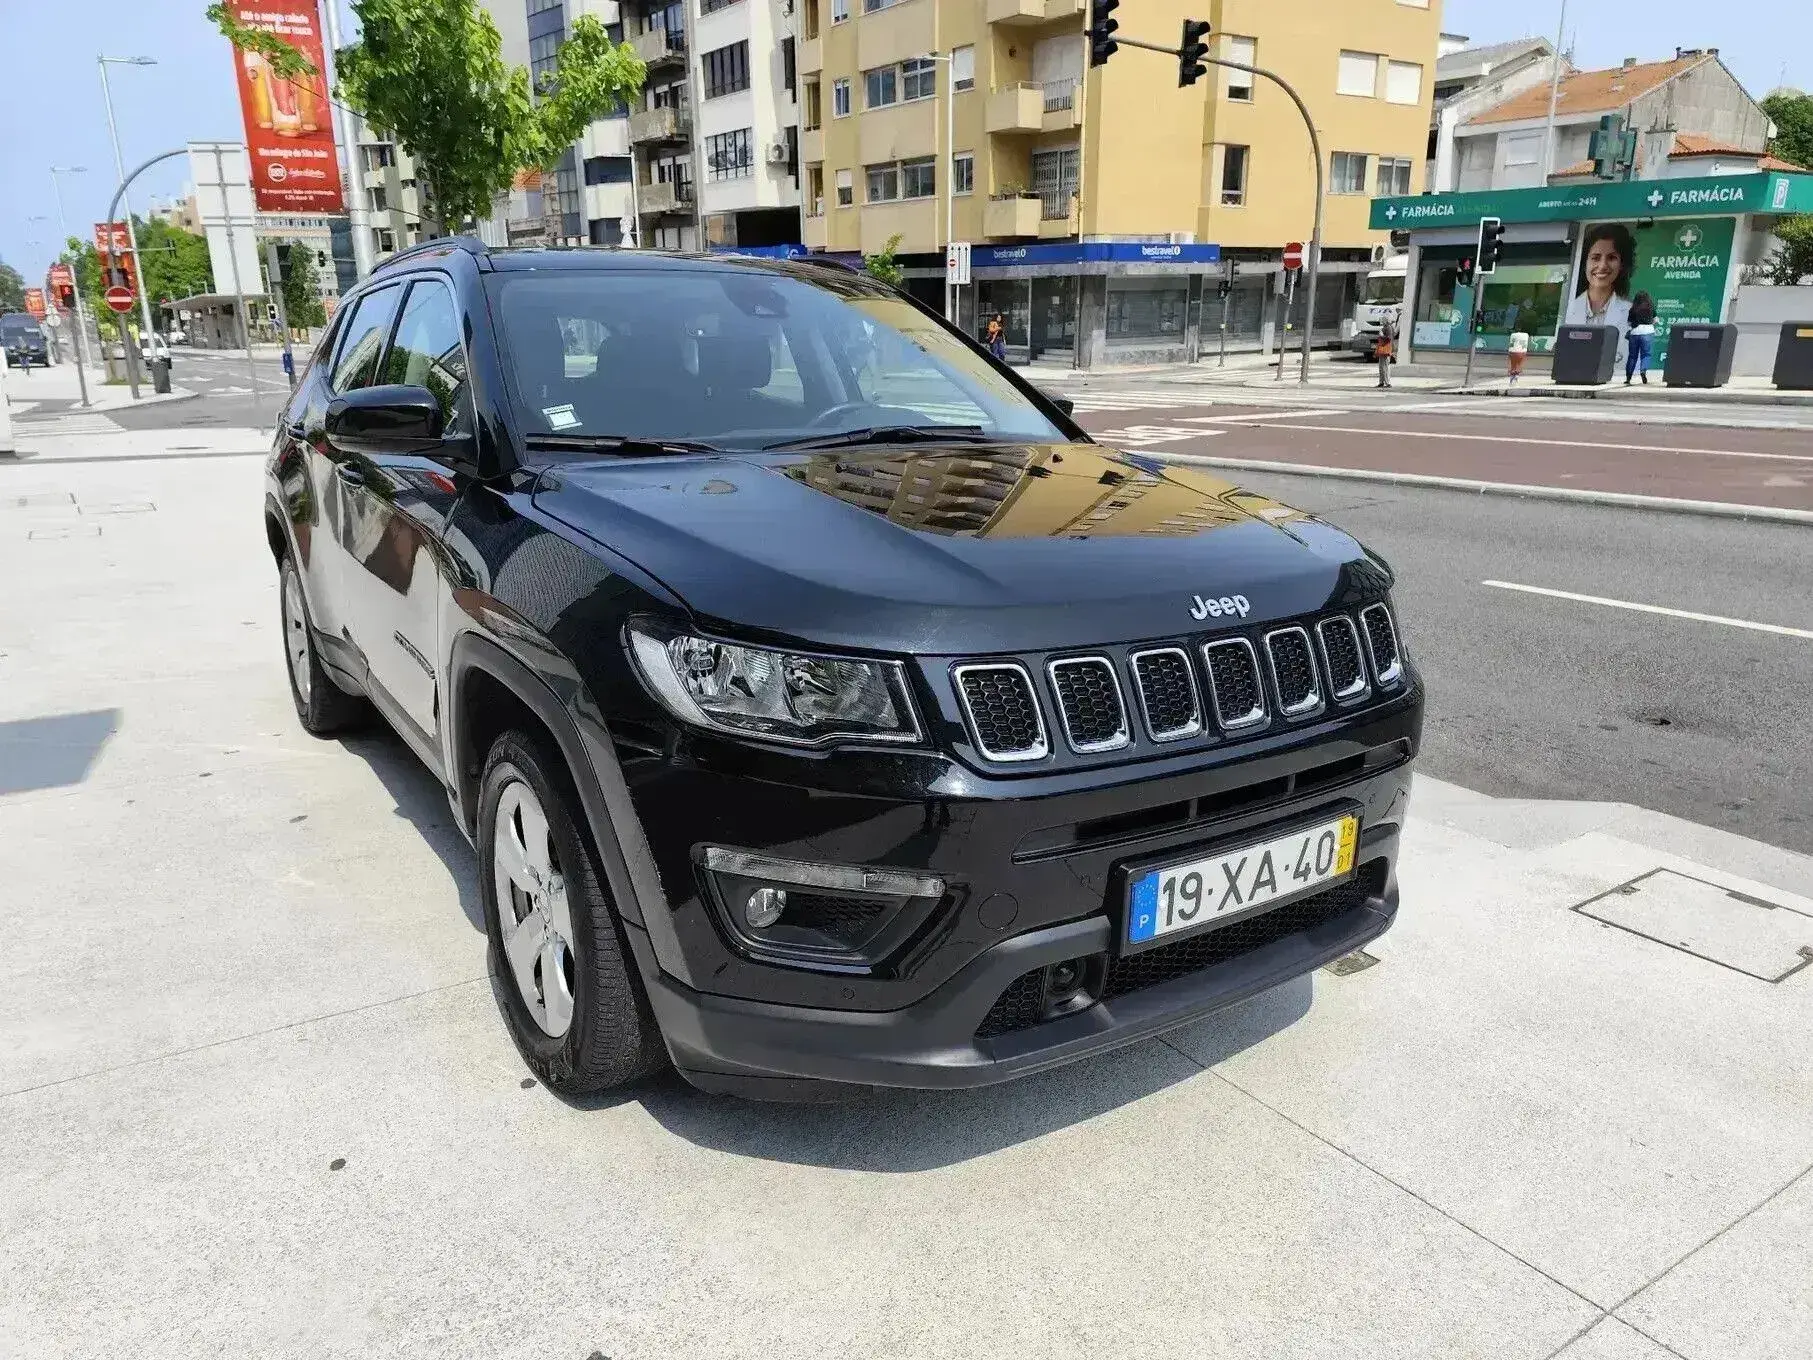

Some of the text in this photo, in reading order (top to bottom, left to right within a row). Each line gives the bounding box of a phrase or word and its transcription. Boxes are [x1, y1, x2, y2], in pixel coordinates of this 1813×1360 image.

[1578, 197, 1597, 206] 24H
[1670, 185, 1744, 204] FARMÁCIA
[1402, 203, 1454, 218] FARMÁCIA
[1650, 251, 1720, 269] FARMÁCIA
[1664, 270, 1701, 279] AVENIDA
[1189, 593, 1251, 621] Jeep
[1341, 824, 1354, 839] 19
[1337, 852, 1351, 869] 01
[1138, 915, 1149, 929] P
